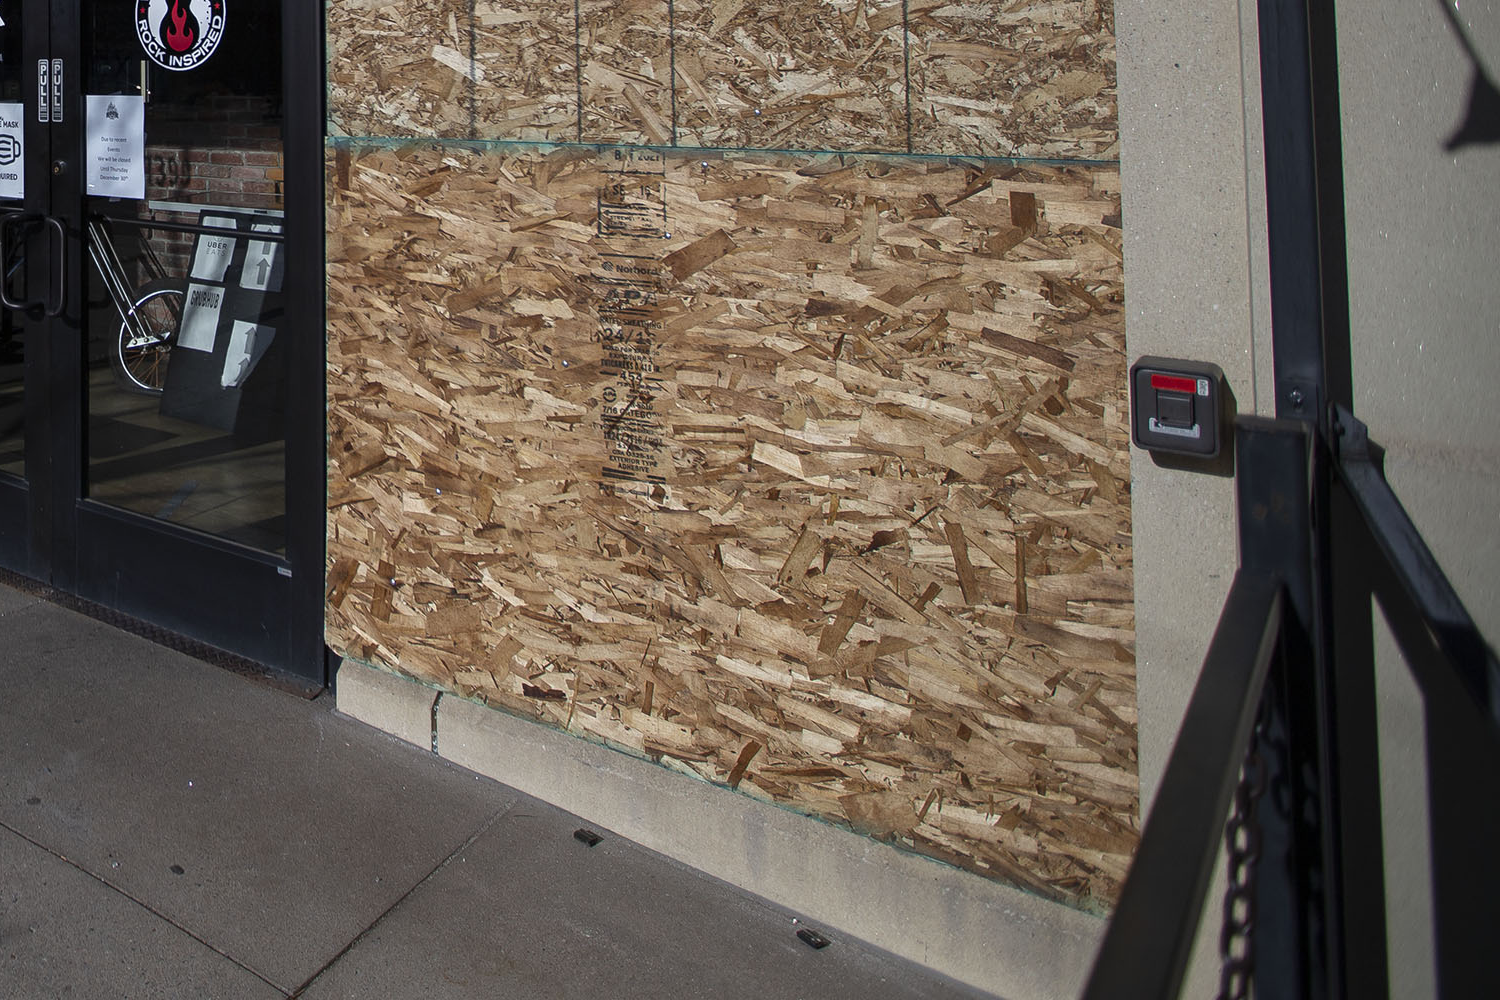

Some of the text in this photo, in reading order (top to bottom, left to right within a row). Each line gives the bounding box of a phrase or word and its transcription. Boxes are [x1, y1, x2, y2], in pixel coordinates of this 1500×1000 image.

[139, 15, 222, 67] ROCK INSPIRED
[53, 64, 61, 106] PULL
[207, 241, 228, 250] UBER
[191, 290, 220, 309] GRUBHUB
